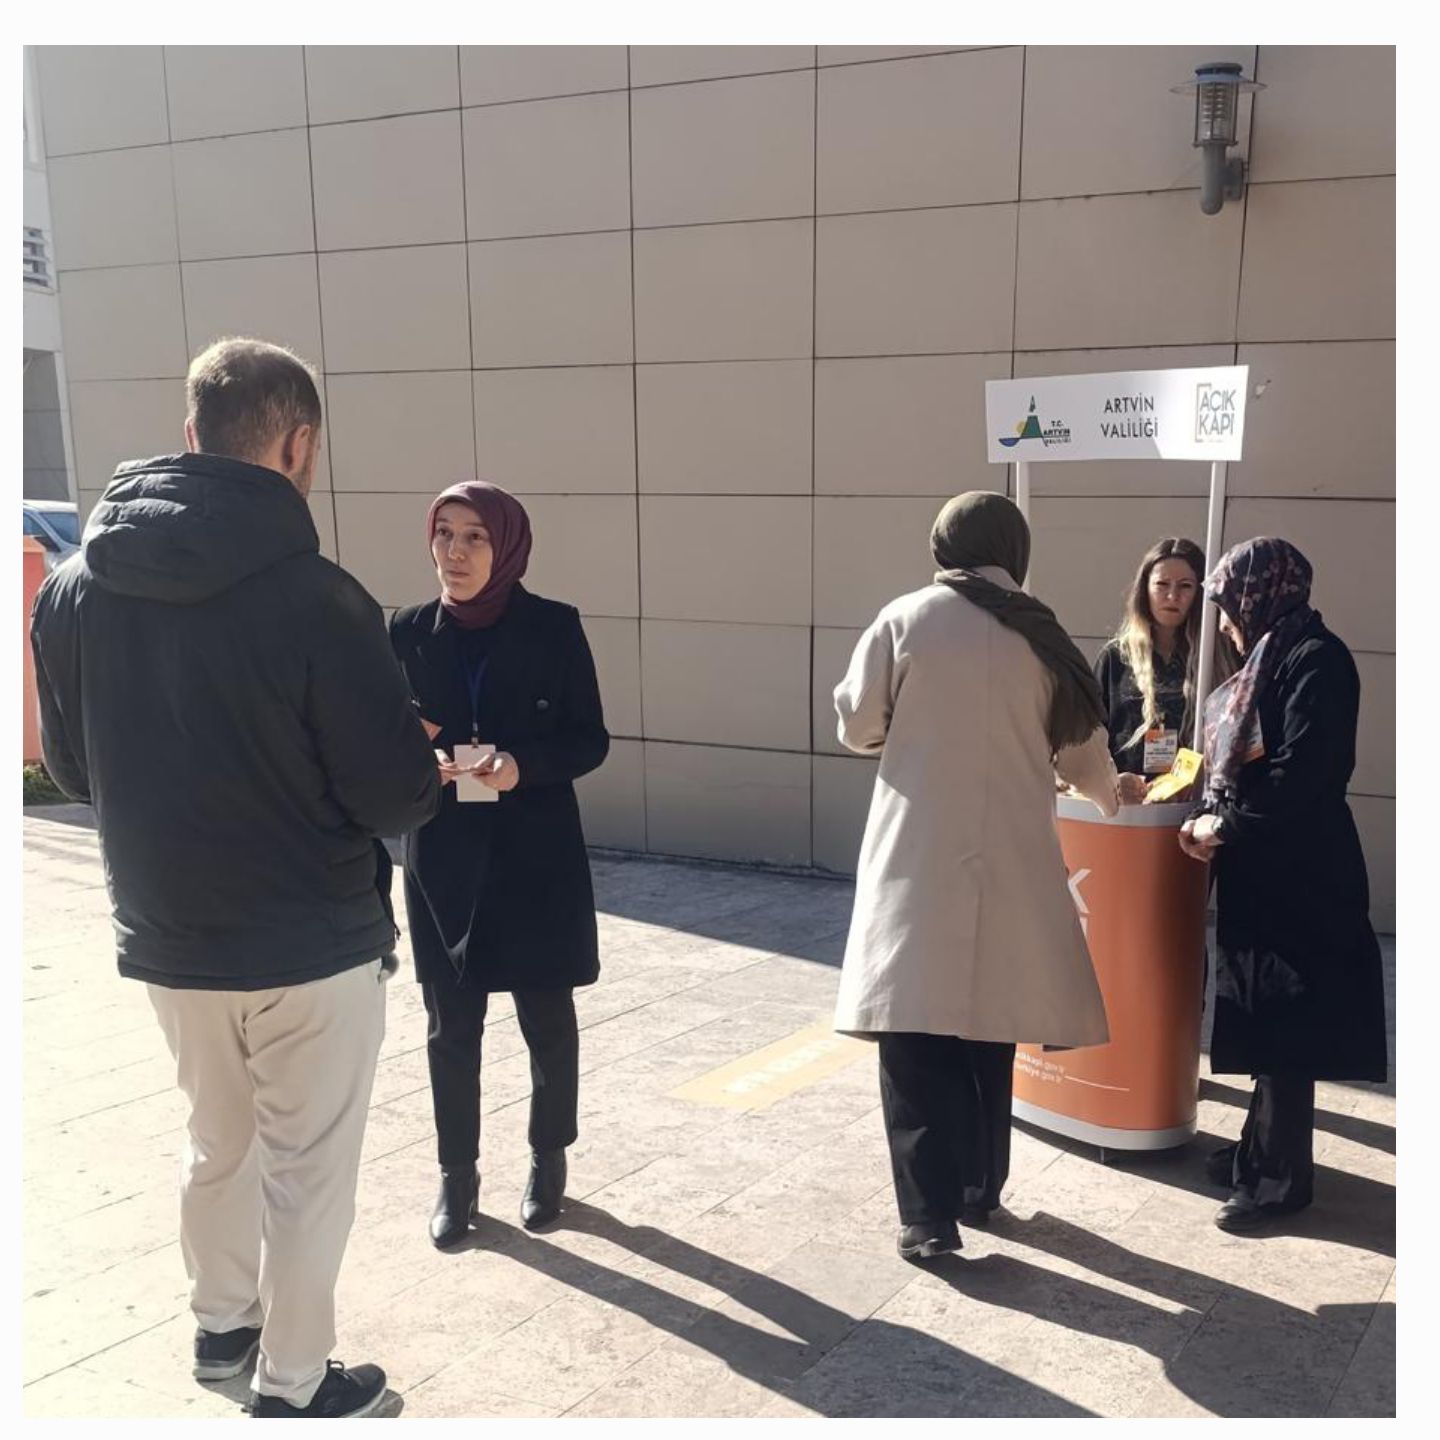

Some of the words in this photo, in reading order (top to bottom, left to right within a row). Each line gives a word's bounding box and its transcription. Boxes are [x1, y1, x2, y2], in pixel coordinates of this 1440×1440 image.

[1104, 393, 1154, 413] ARTVİN
[1199, 389, 1236, 412] AÇIK
[1100, 417, 1159, 438] VALİLİĞİ
[1199, 412, 1234, 435] KAPI
